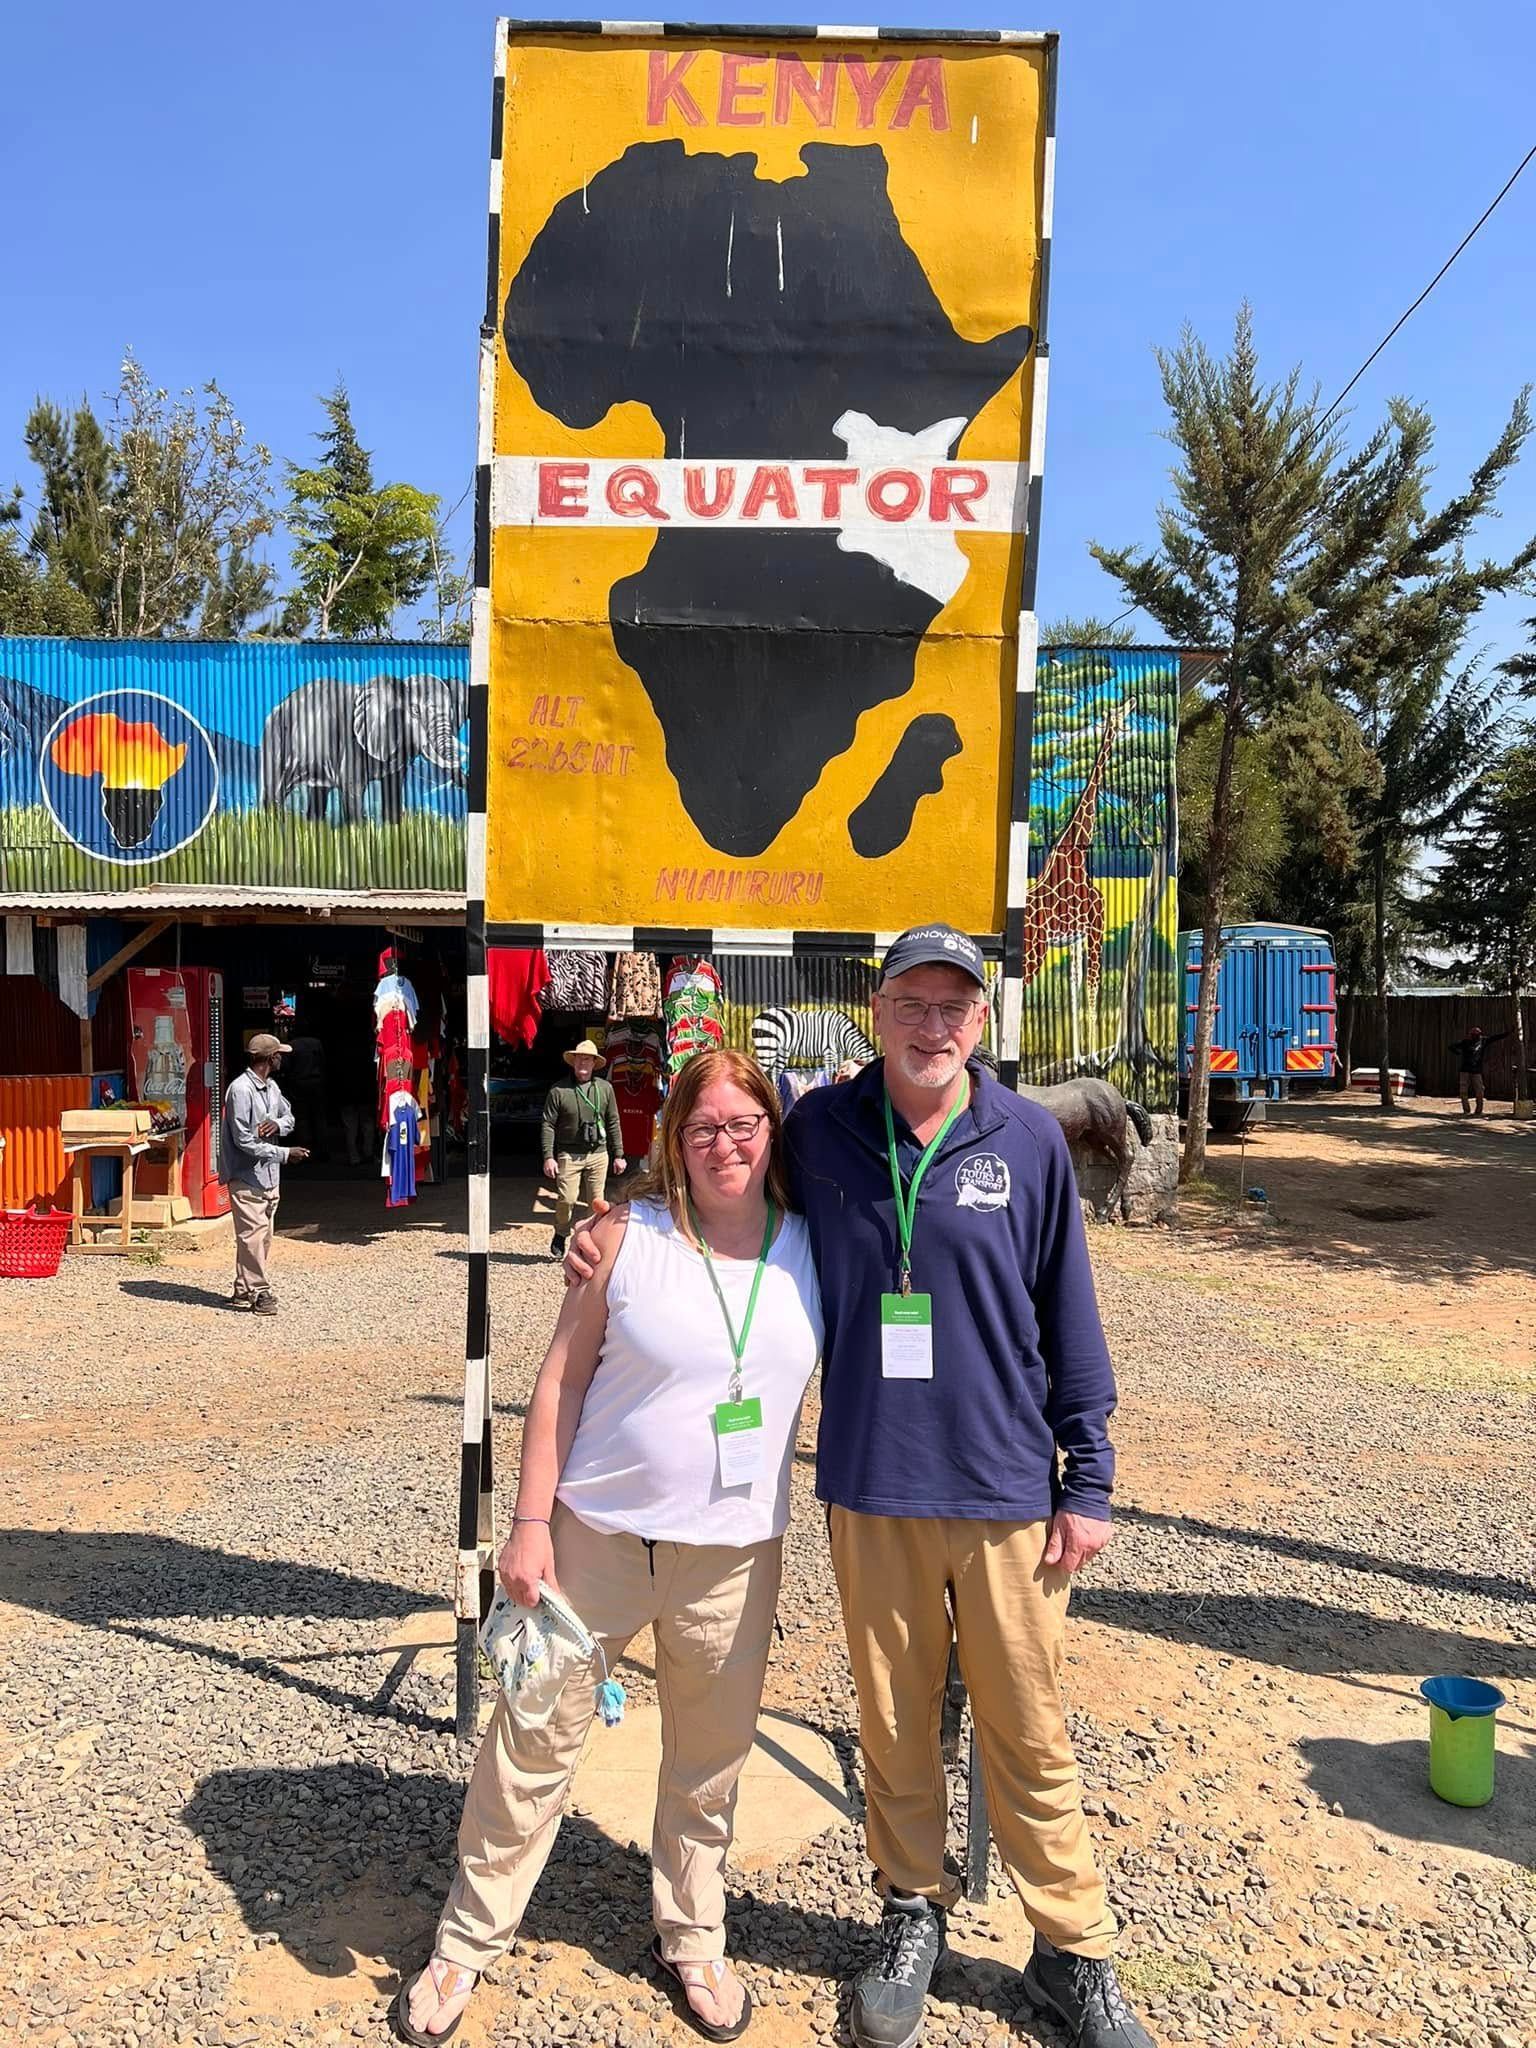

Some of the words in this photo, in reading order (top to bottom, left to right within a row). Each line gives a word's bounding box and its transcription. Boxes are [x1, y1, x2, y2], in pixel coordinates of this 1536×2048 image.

[645, 50, 953, 133] KENYA
[537, 462, 990, 522] EQUATOR
[529, 694, 585, 728] ALT
[907, 930, 977, 951] INNOVATION
[961, 1168, 995, 1182] TOURS
[974, 1158, 993, 1173] 6A
